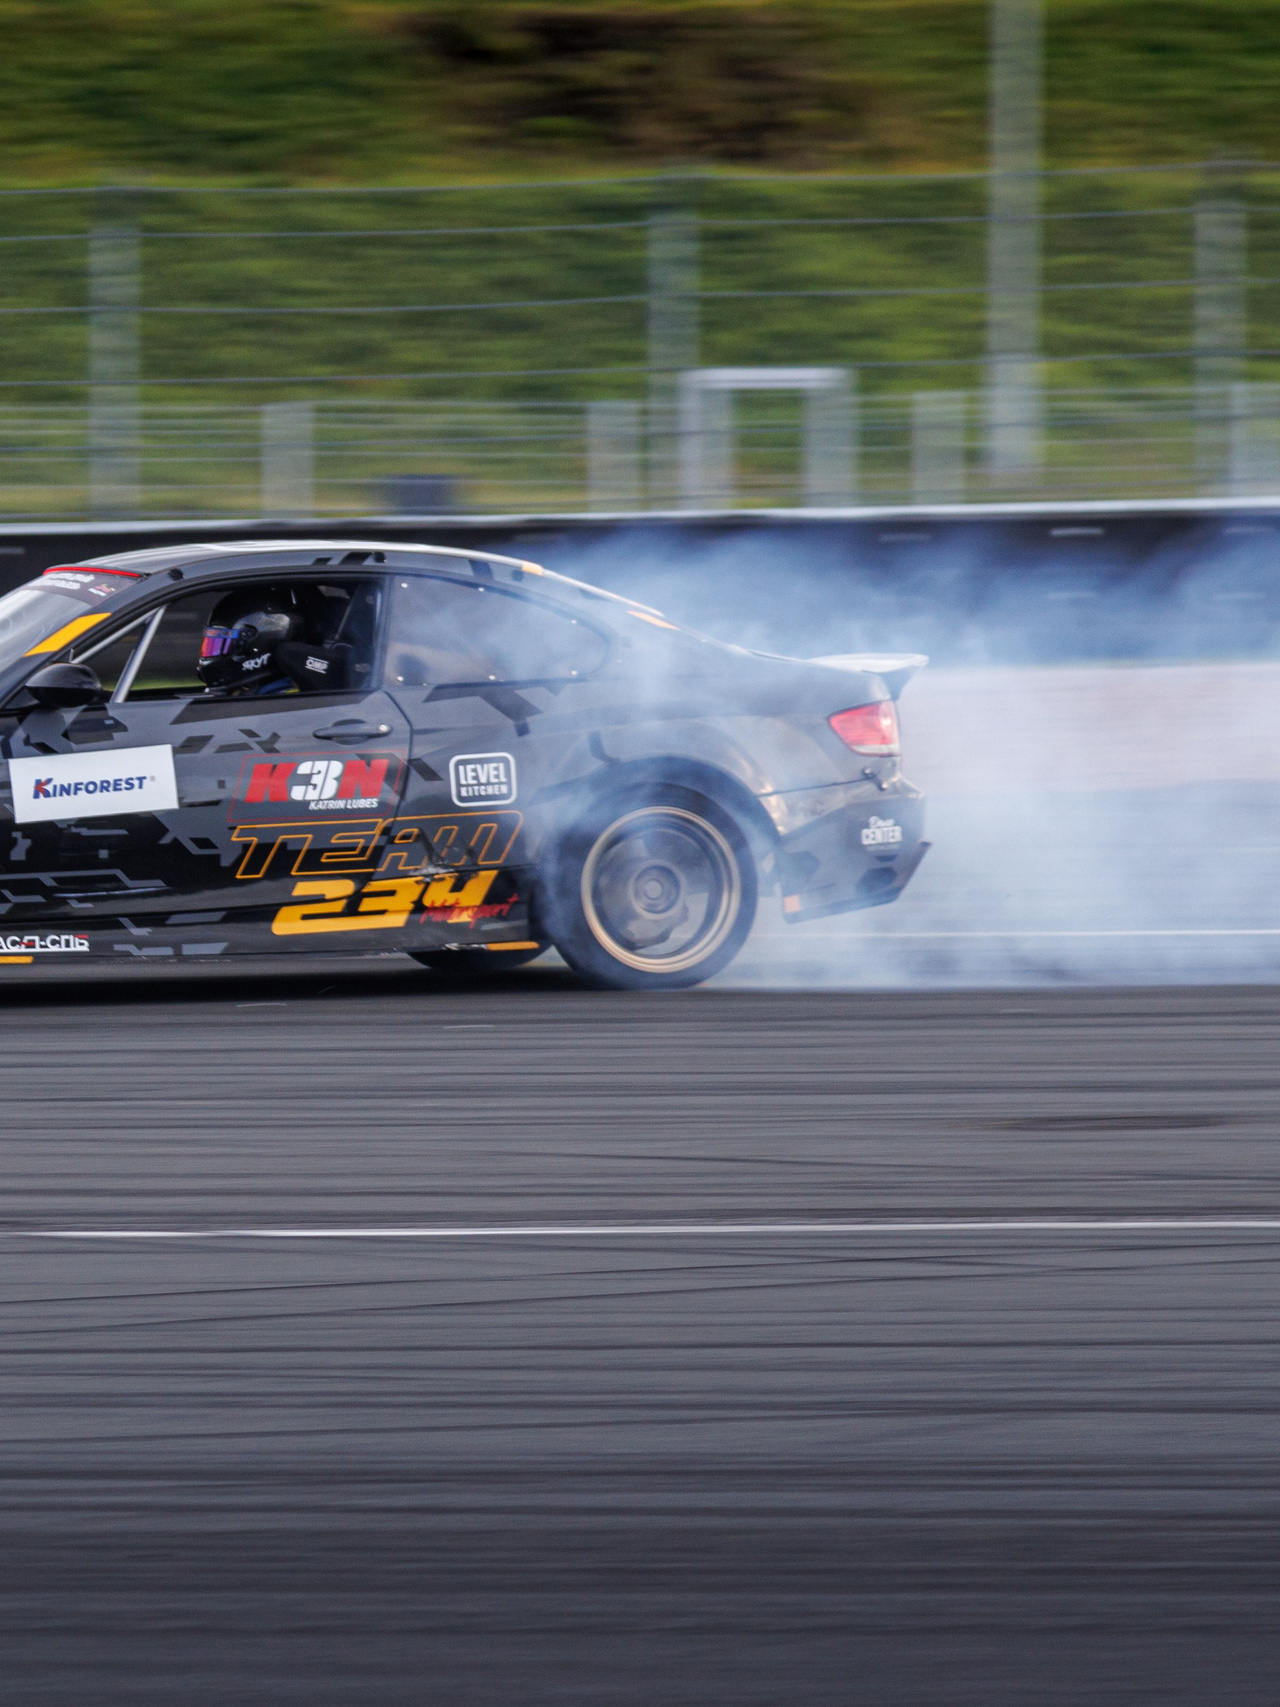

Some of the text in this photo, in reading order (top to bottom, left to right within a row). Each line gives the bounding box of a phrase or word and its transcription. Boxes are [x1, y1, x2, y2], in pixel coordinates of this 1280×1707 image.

[458, 763, 507, 785] LEVEL
[33, 777, 147, 799] KINFOREST
[460, 784, 508, 797] KITCHEN
[308, 798, 379, 810] KATRIN LUBES
[271, 870, 498, 935] 234
